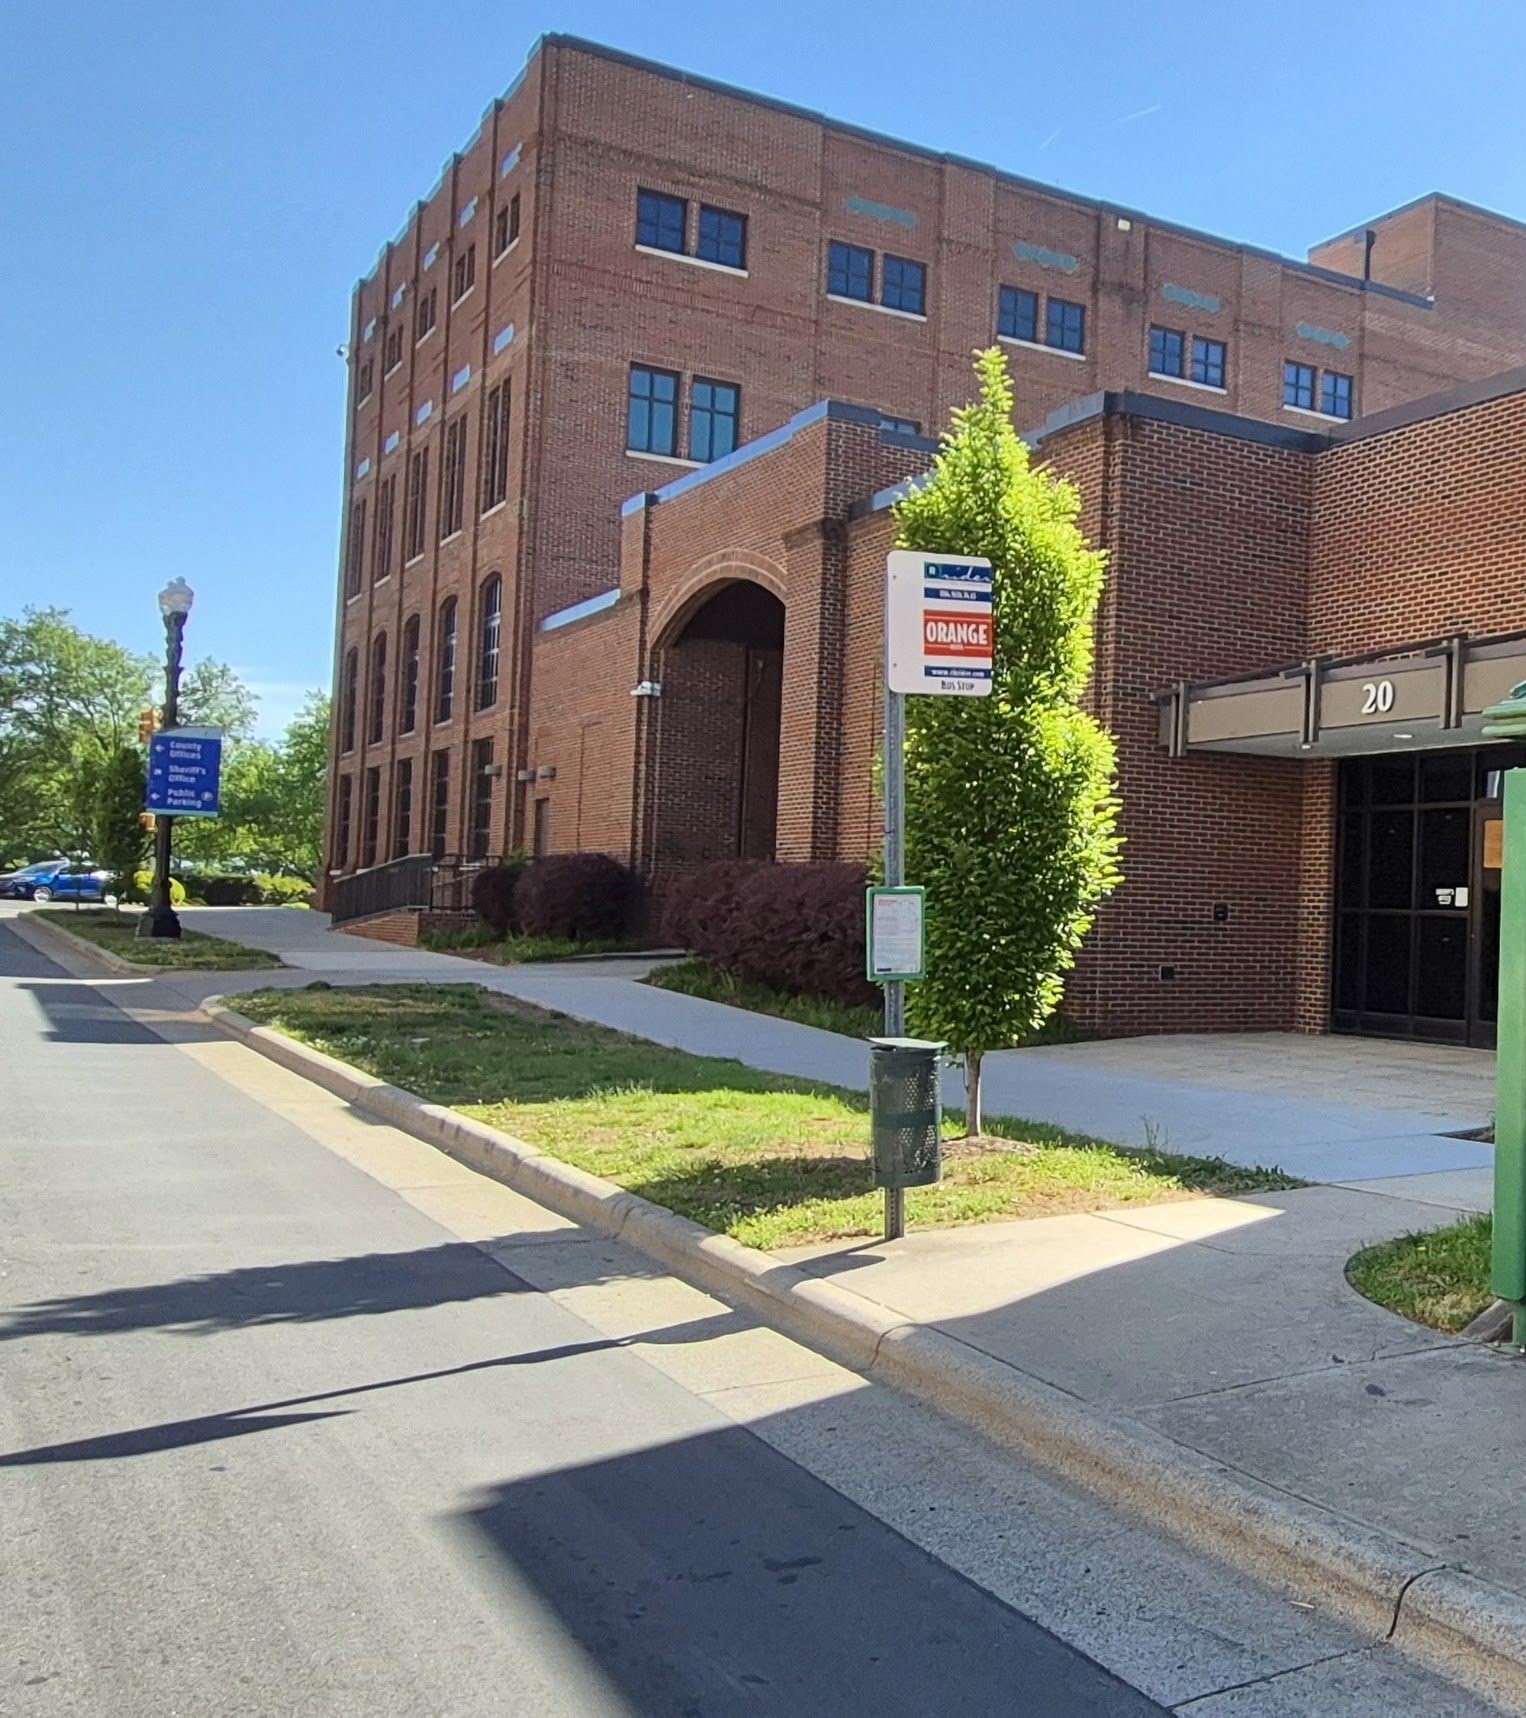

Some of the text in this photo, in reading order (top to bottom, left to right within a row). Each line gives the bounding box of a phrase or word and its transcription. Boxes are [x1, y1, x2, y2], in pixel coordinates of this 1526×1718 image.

[926, 621, 988, 645] ORANGE
[1361, 680, 1394, 714] 20
[170, 741, 202, 751] County
[169, 765, 206, 775] Sheriff's
[168, 774, 196, 783] Office
[167, 788, 195, 797] Public
[167, 797, 202, 808] Parking
